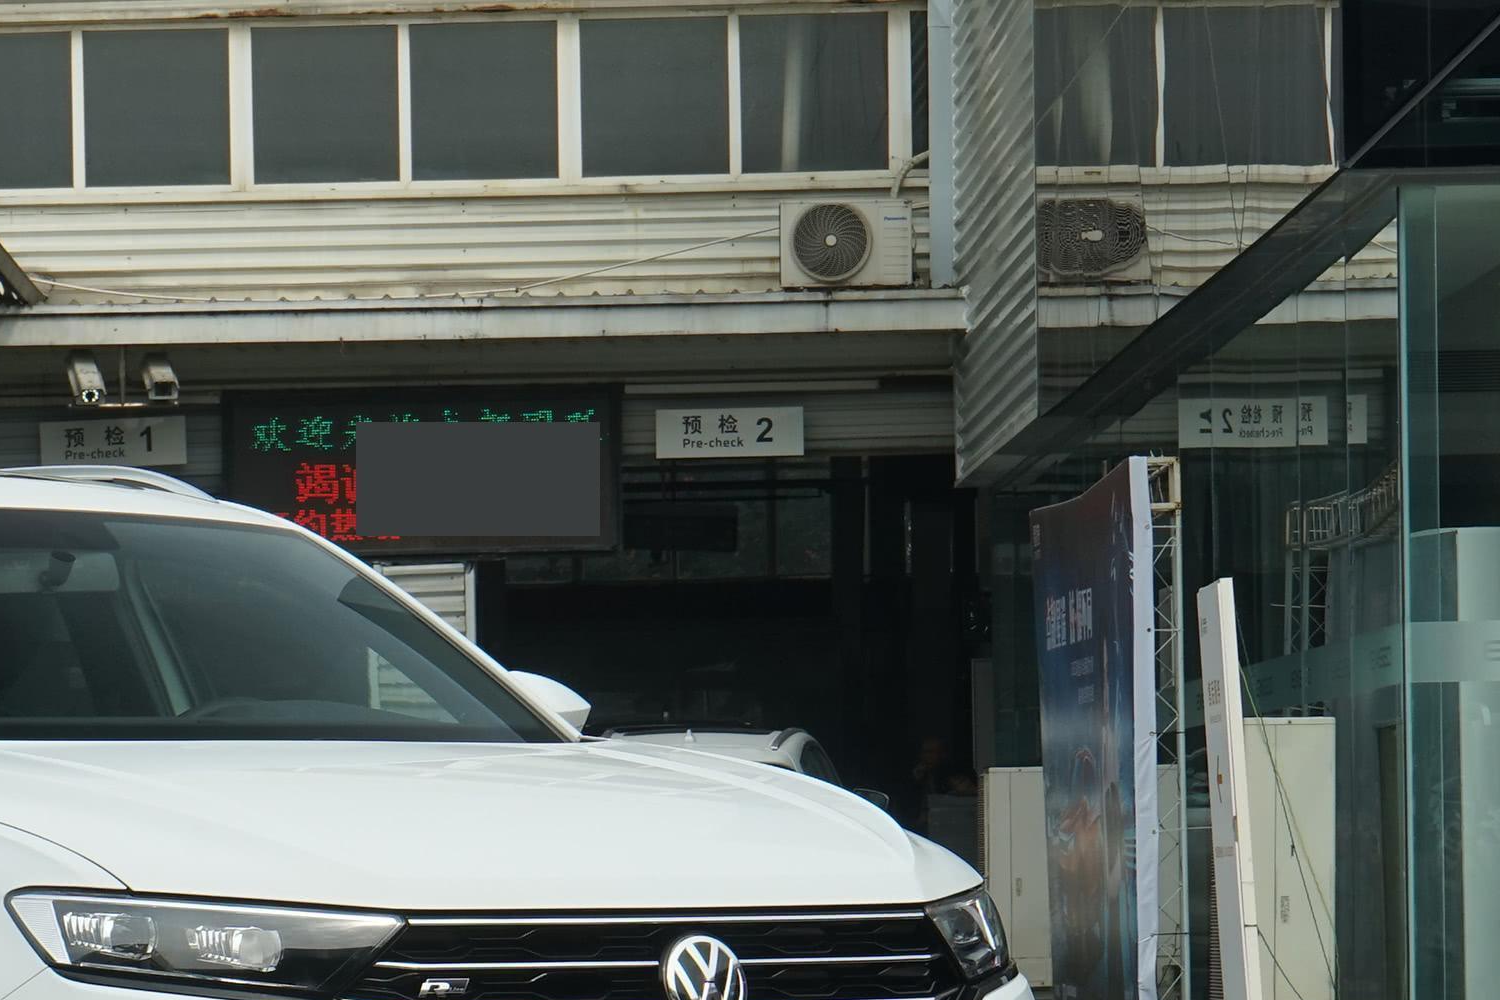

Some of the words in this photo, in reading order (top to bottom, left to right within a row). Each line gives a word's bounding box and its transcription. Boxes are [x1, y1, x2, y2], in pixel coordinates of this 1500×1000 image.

[63, 426, 125, 448] 预检
[139, 425, 152, 452] 1
[681, 414, 738, 435] 预检
[755, 417, 773, 443] 2
[682, 437, 744, 448] Pre-check
[64, 447, 125, 461] Pre-check
